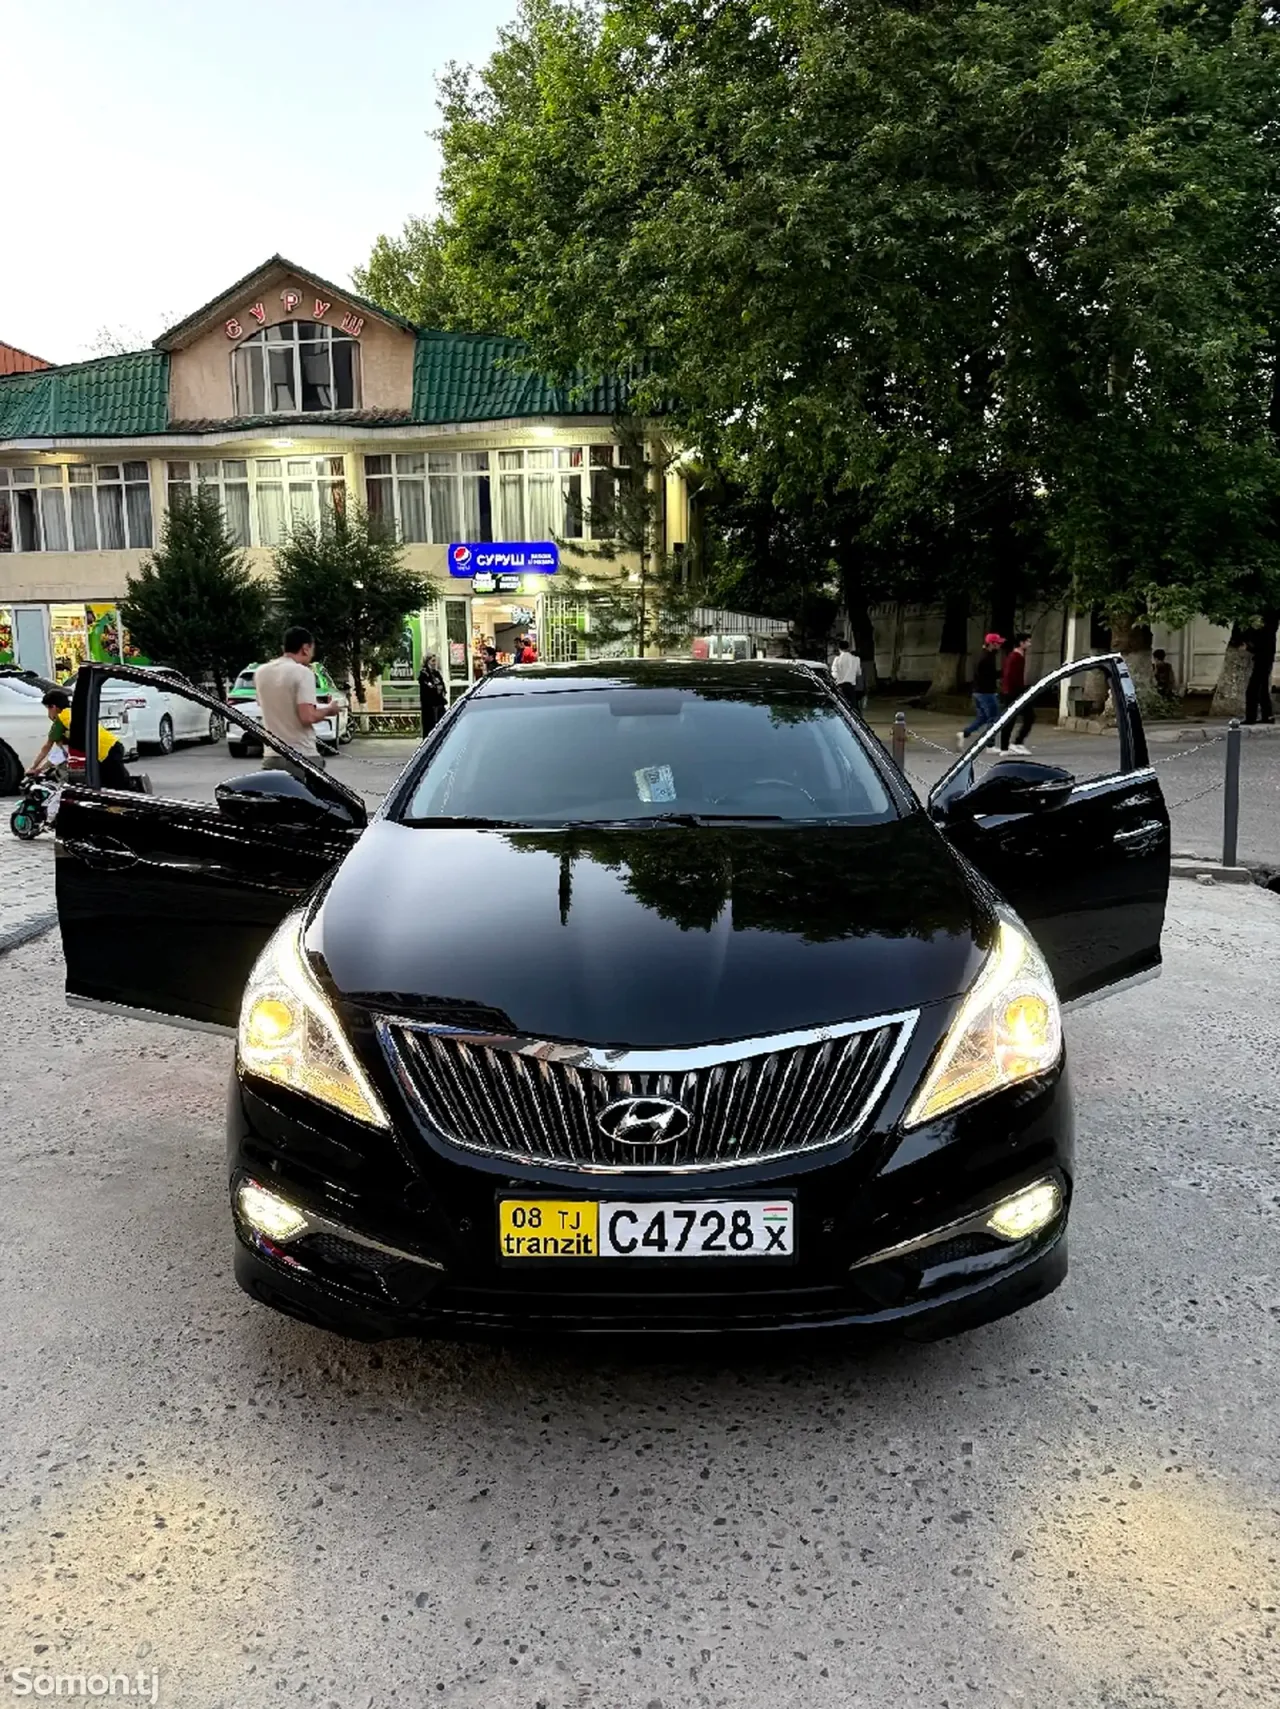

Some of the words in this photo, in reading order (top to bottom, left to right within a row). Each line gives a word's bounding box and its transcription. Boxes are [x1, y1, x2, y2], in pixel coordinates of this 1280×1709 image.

[225, 293, 365, 339] СУРУШ
[476, 553, 525, 566] СУРУШ
[511, 1207, 542, 1229] 08
[557, 1210, 582, 1230] TJ
[608, 1208, 754, 1254] C4728
[503, 1232, 593, 1255] tranzit
